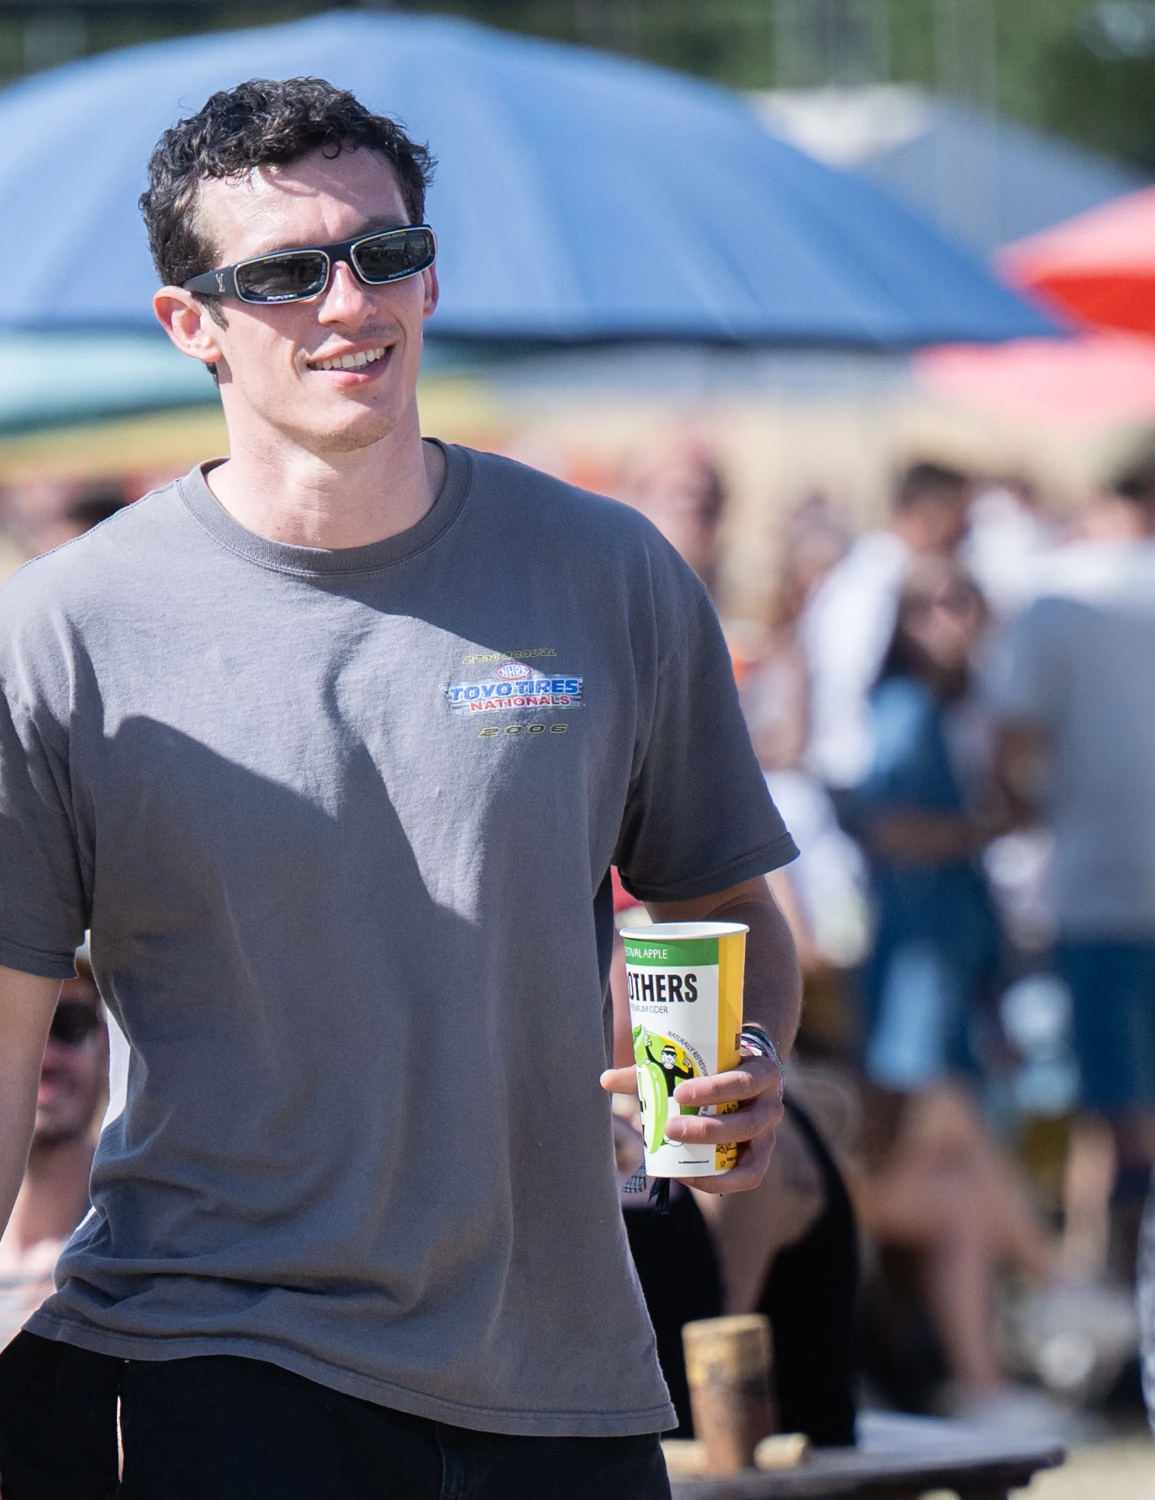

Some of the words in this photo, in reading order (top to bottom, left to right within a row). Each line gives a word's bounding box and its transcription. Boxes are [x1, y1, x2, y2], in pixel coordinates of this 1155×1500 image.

[500, 665, 528, 678] NHRA
[450, 682, 513, 701] TOYO
[515, 679, 579, 695] TIRES
[470, 695, 570, 711] NATIONALS
[478, 724, 568, 738] 2006
[643, 949, 668, 960] APPLE
